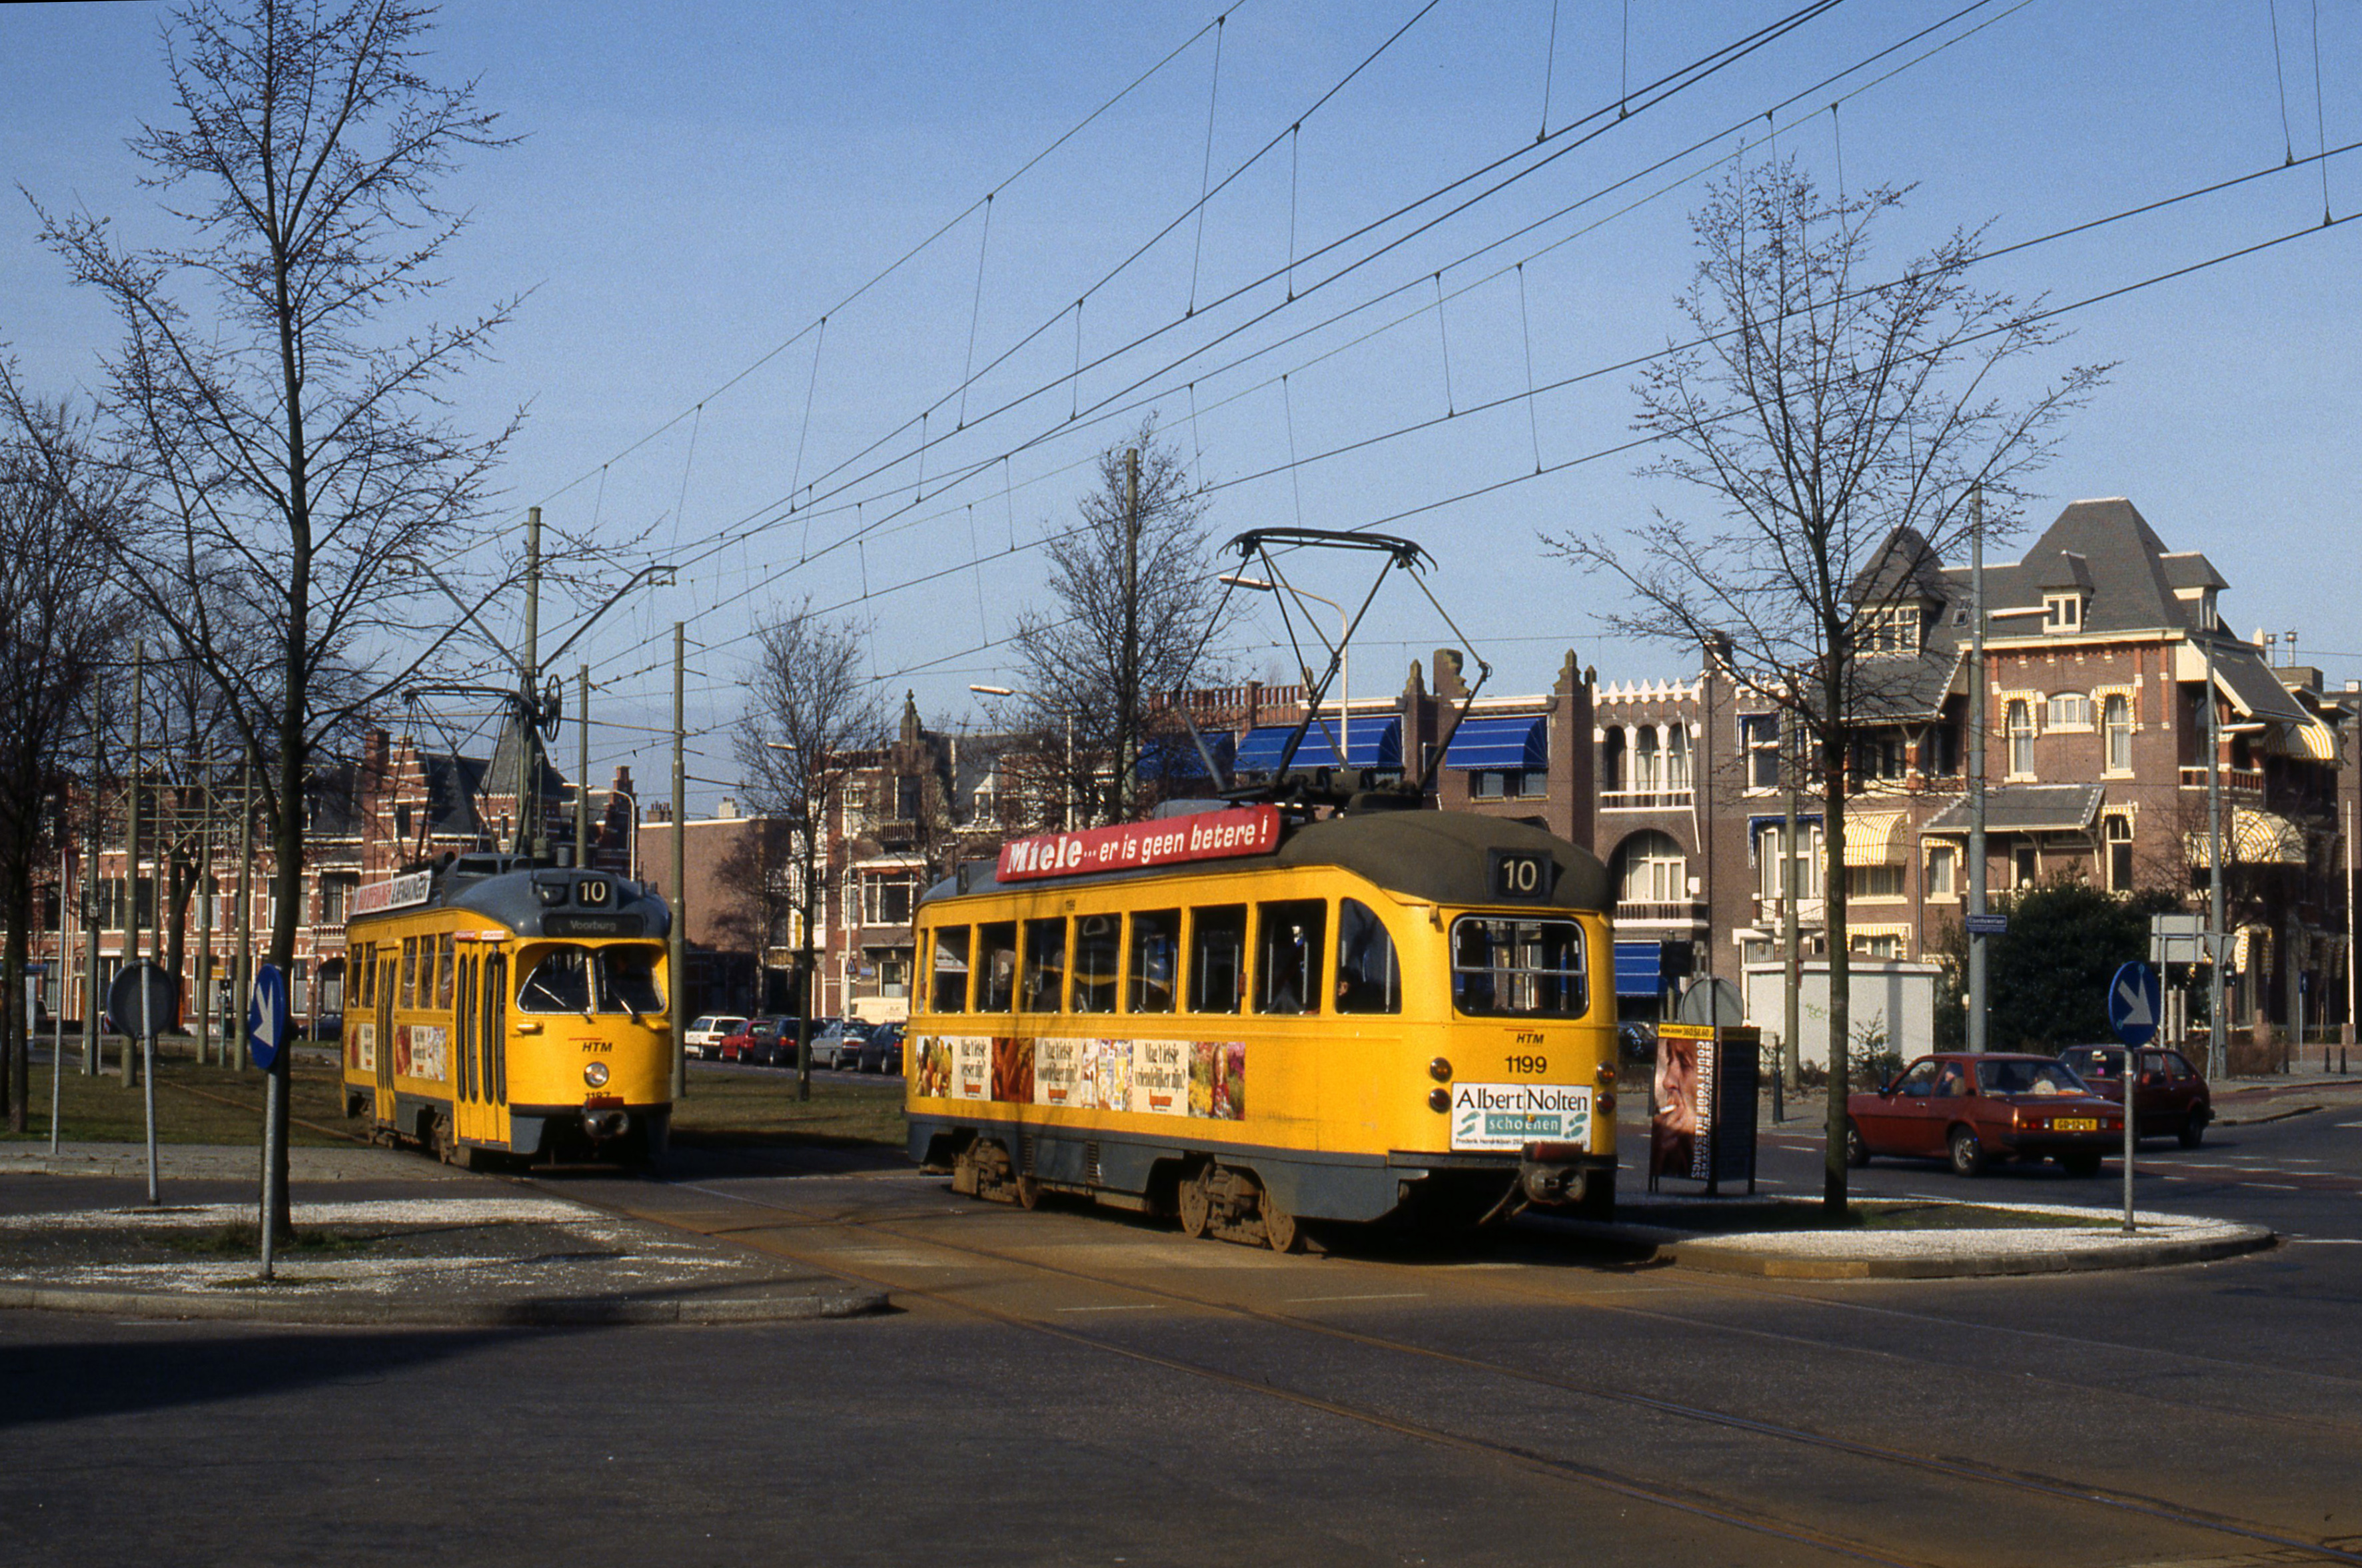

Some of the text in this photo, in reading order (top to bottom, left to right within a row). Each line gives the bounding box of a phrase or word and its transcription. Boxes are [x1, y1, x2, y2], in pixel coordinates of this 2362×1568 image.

[1099, 841, 1118, 863] er
[1121, 835, 1136, 859] is
[1141, 833, 1185, 864] geen
[1503, 860, 1537, 891] 10
[580, 881, 606, 902] 10
[570, 921, 617, 932] Voorburg
[582, 1042, 613, 1052] HTM
[1516, 1033, 1544, 1044] HTM
[1504, 1056, 1547, 1074] 1199
[1456, 1088, 1588, 1111] Albert Nolten
[1691, 1041, 1705, 1178] COUNT YOUR BLESSINGS
[1489, 1116, 1558, 1132] schoenen
